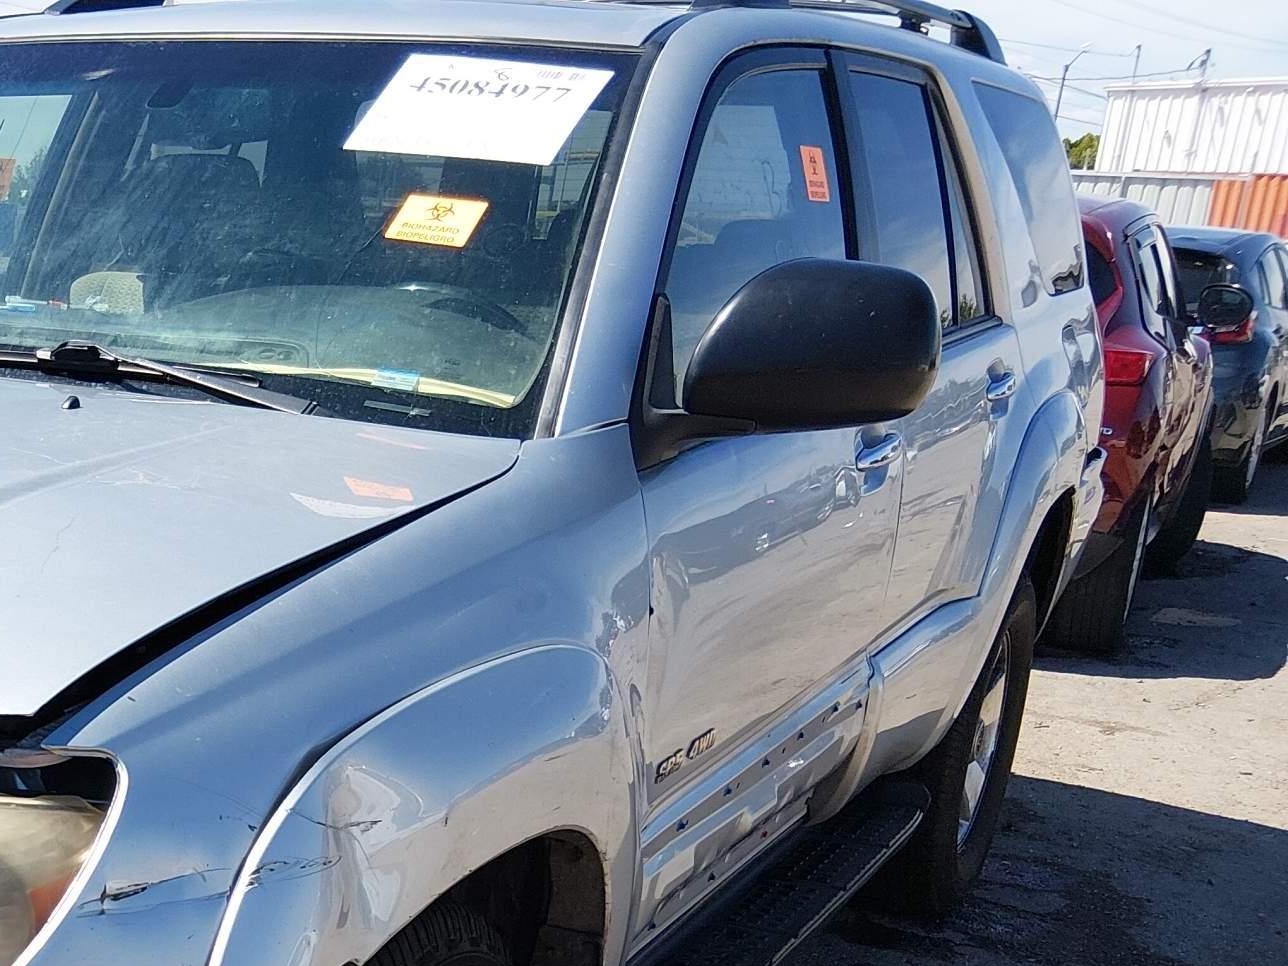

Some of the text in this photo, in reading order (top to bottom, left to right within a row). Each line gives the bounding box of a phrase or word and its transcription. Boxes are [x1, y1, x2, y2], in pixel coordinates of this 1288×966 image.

[409, 76, 572, 103] 45084977
[401, 221, 461, 235] BIOHAZARD
[395, 230, 456, 244] BIOPELIGRO
